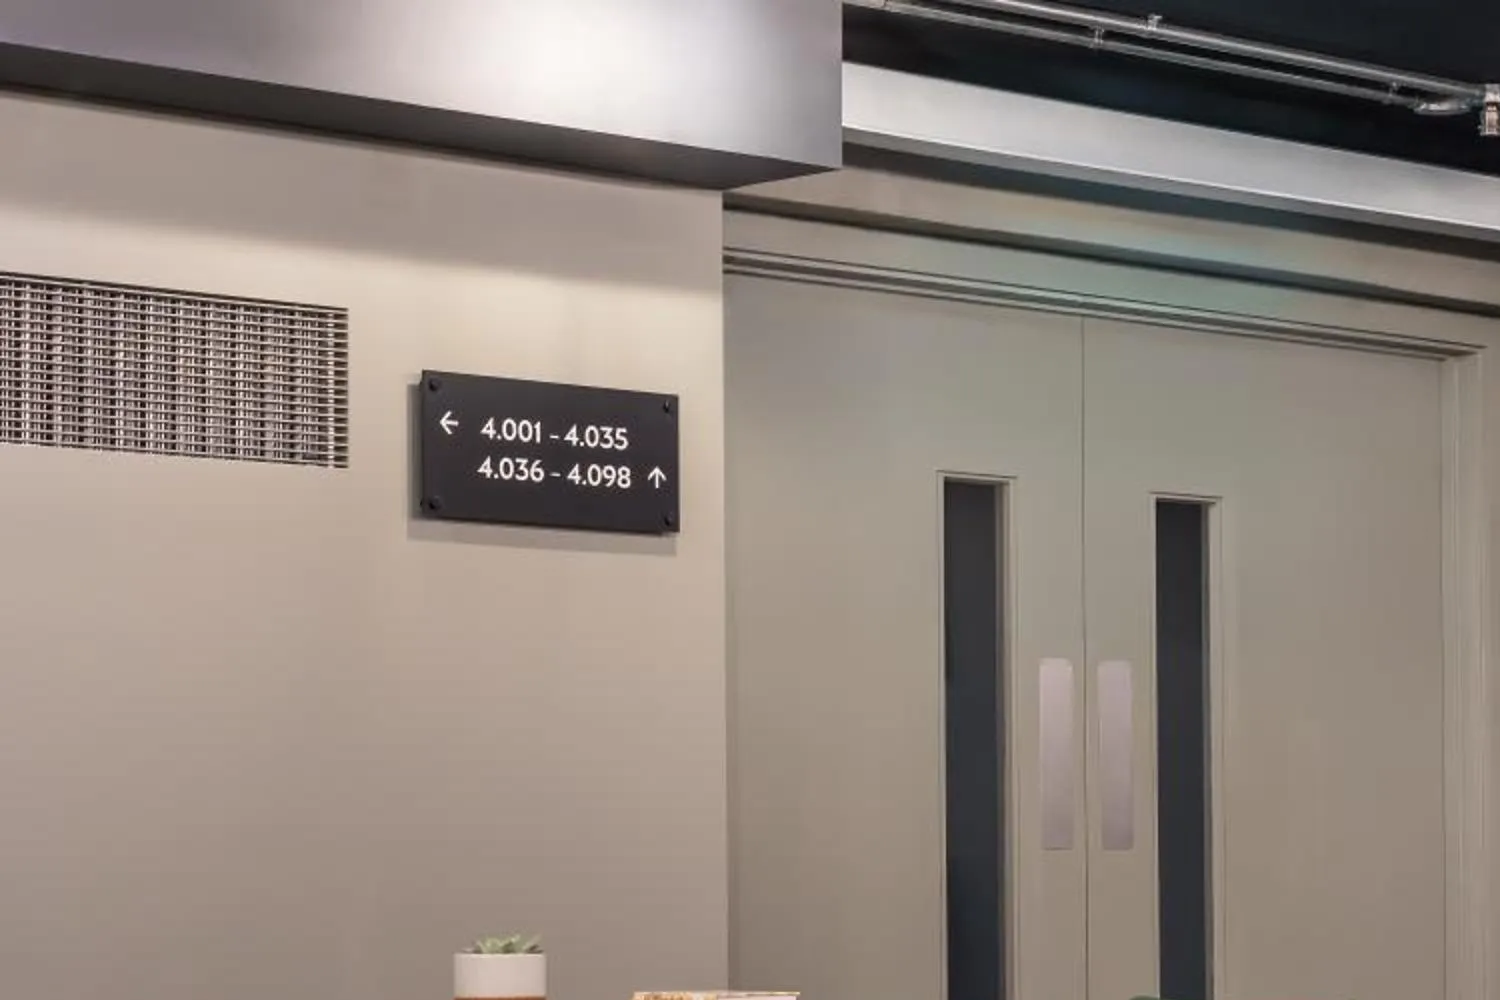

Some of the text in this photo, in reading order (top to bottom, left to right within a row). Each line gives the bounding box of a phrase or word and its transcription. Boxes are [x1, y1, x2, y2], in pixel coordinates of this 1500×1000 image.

[479, 416, 542, 444] 4.001
[563, 423, 629, 451] 4.035
[476, 455, 545, 483] 4.036
[566, 463, 632, 489] 4.098
